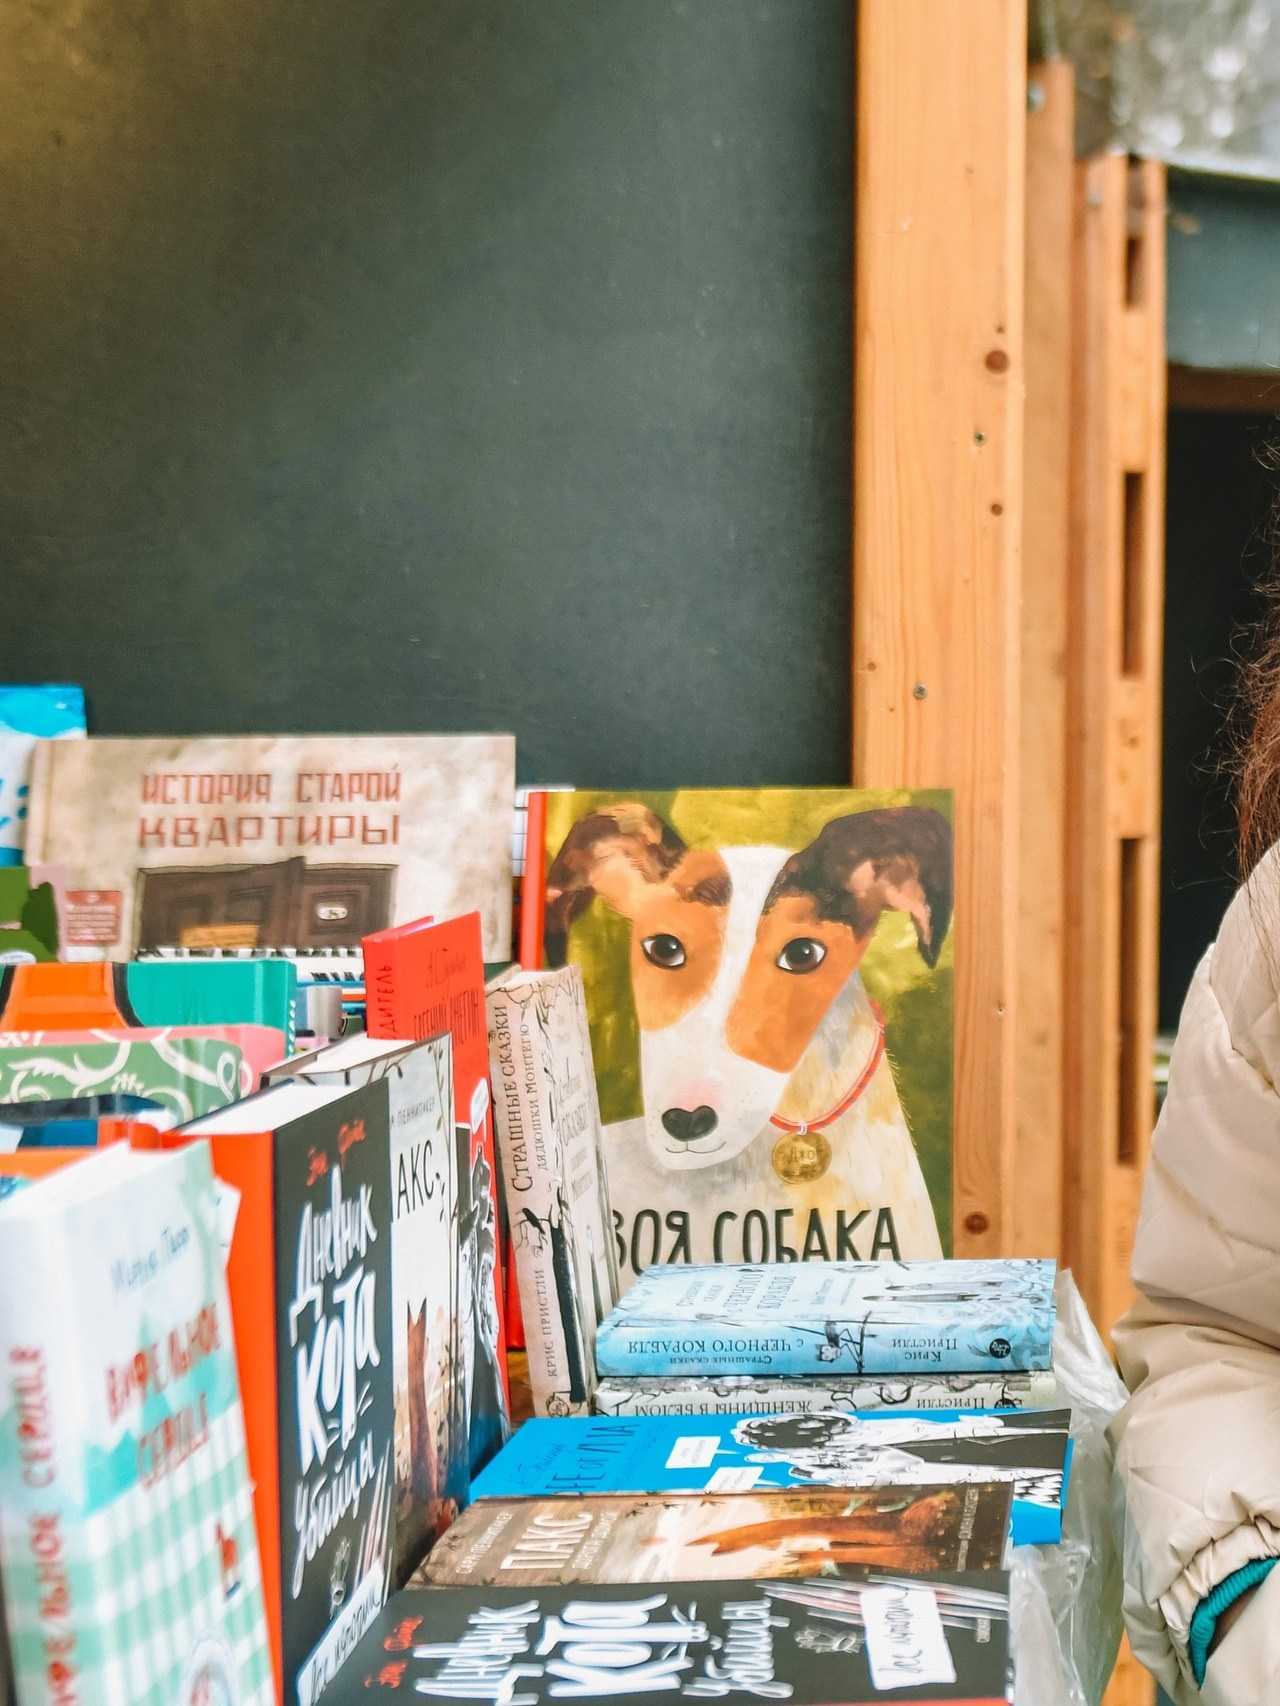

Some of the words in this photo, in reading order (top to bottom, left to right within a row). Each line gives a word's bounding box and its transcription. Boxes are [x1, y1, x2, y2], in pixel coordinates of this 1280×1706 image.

[141, 773, 271, 804] ИСТОРИЯ
[296, 764, 400, 803] СТАРОЙ
[138, 814, 399, 848] КВАРТИРЫ
[713, 1206, 902, 1263] СОБАКА
[628, 1339, 706, 1354] КОРАБЛЯ
[712, 1338, 792, 1352] ЧЕРНОГО
[635, 1403, 696, 1416] БЕЛОМ
[715, 1400, 813, 1416] ЖЕНЩИНЫ
[500, 1512, 593, 1570] ПАКС
